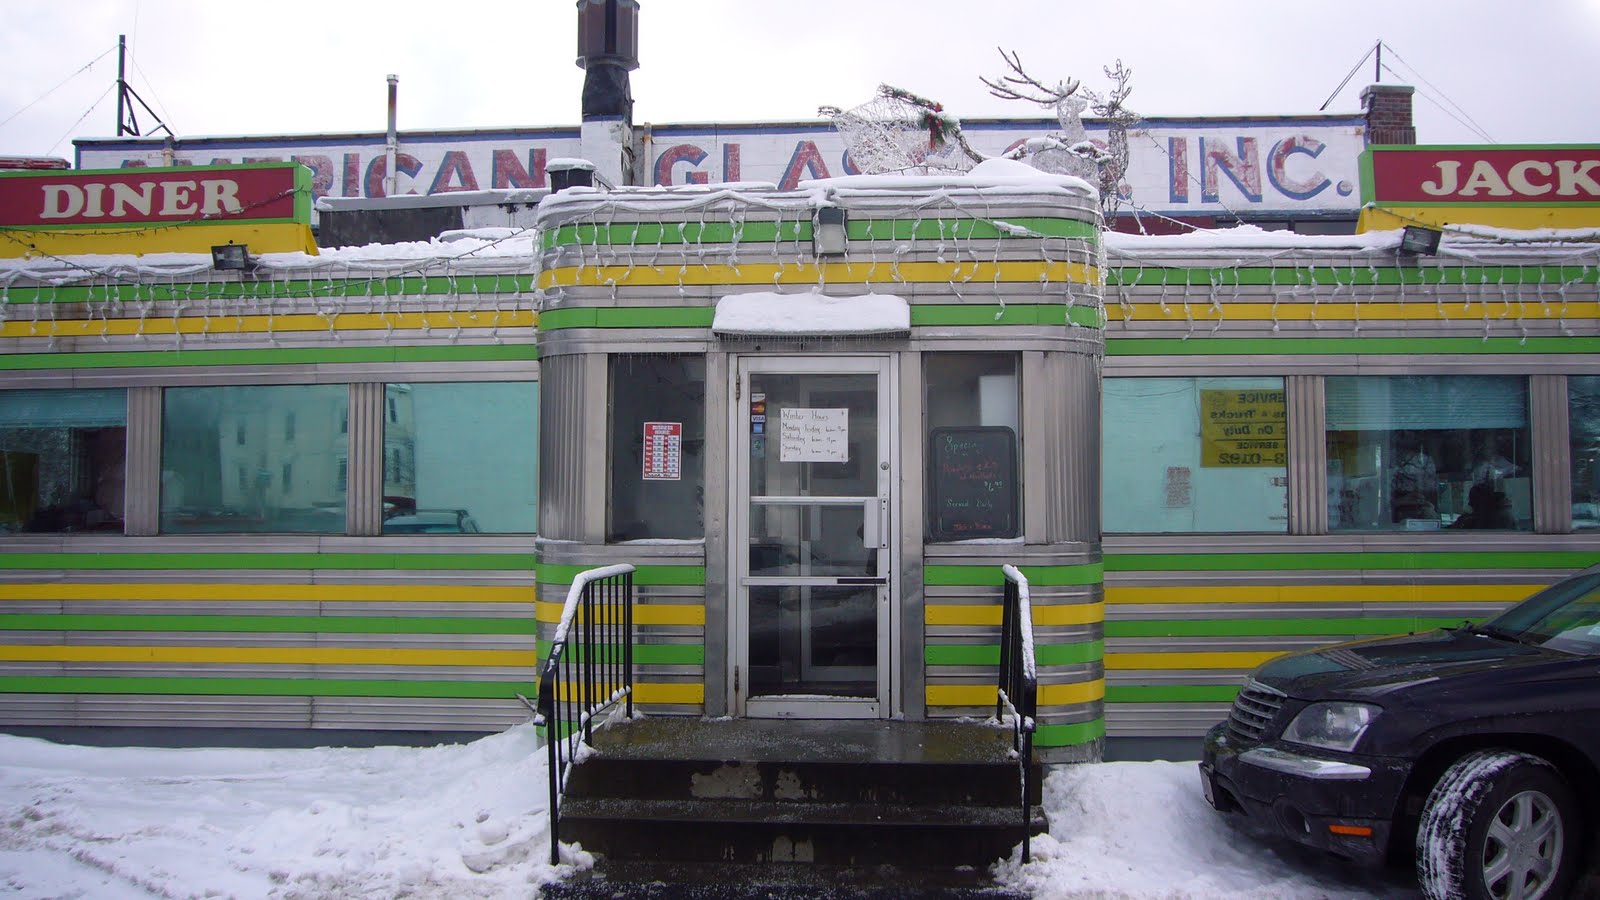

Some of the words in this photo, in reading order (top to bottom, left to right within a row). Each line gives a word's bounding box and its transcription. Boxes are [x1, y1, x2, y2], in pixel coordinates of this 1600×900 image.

[120, 148, 547, 204] RICAN
[1168, 135, 1353, 203] INC.
[1421, 160, 1600, 197] JACK
[39, 179, 244, 219] DINER
